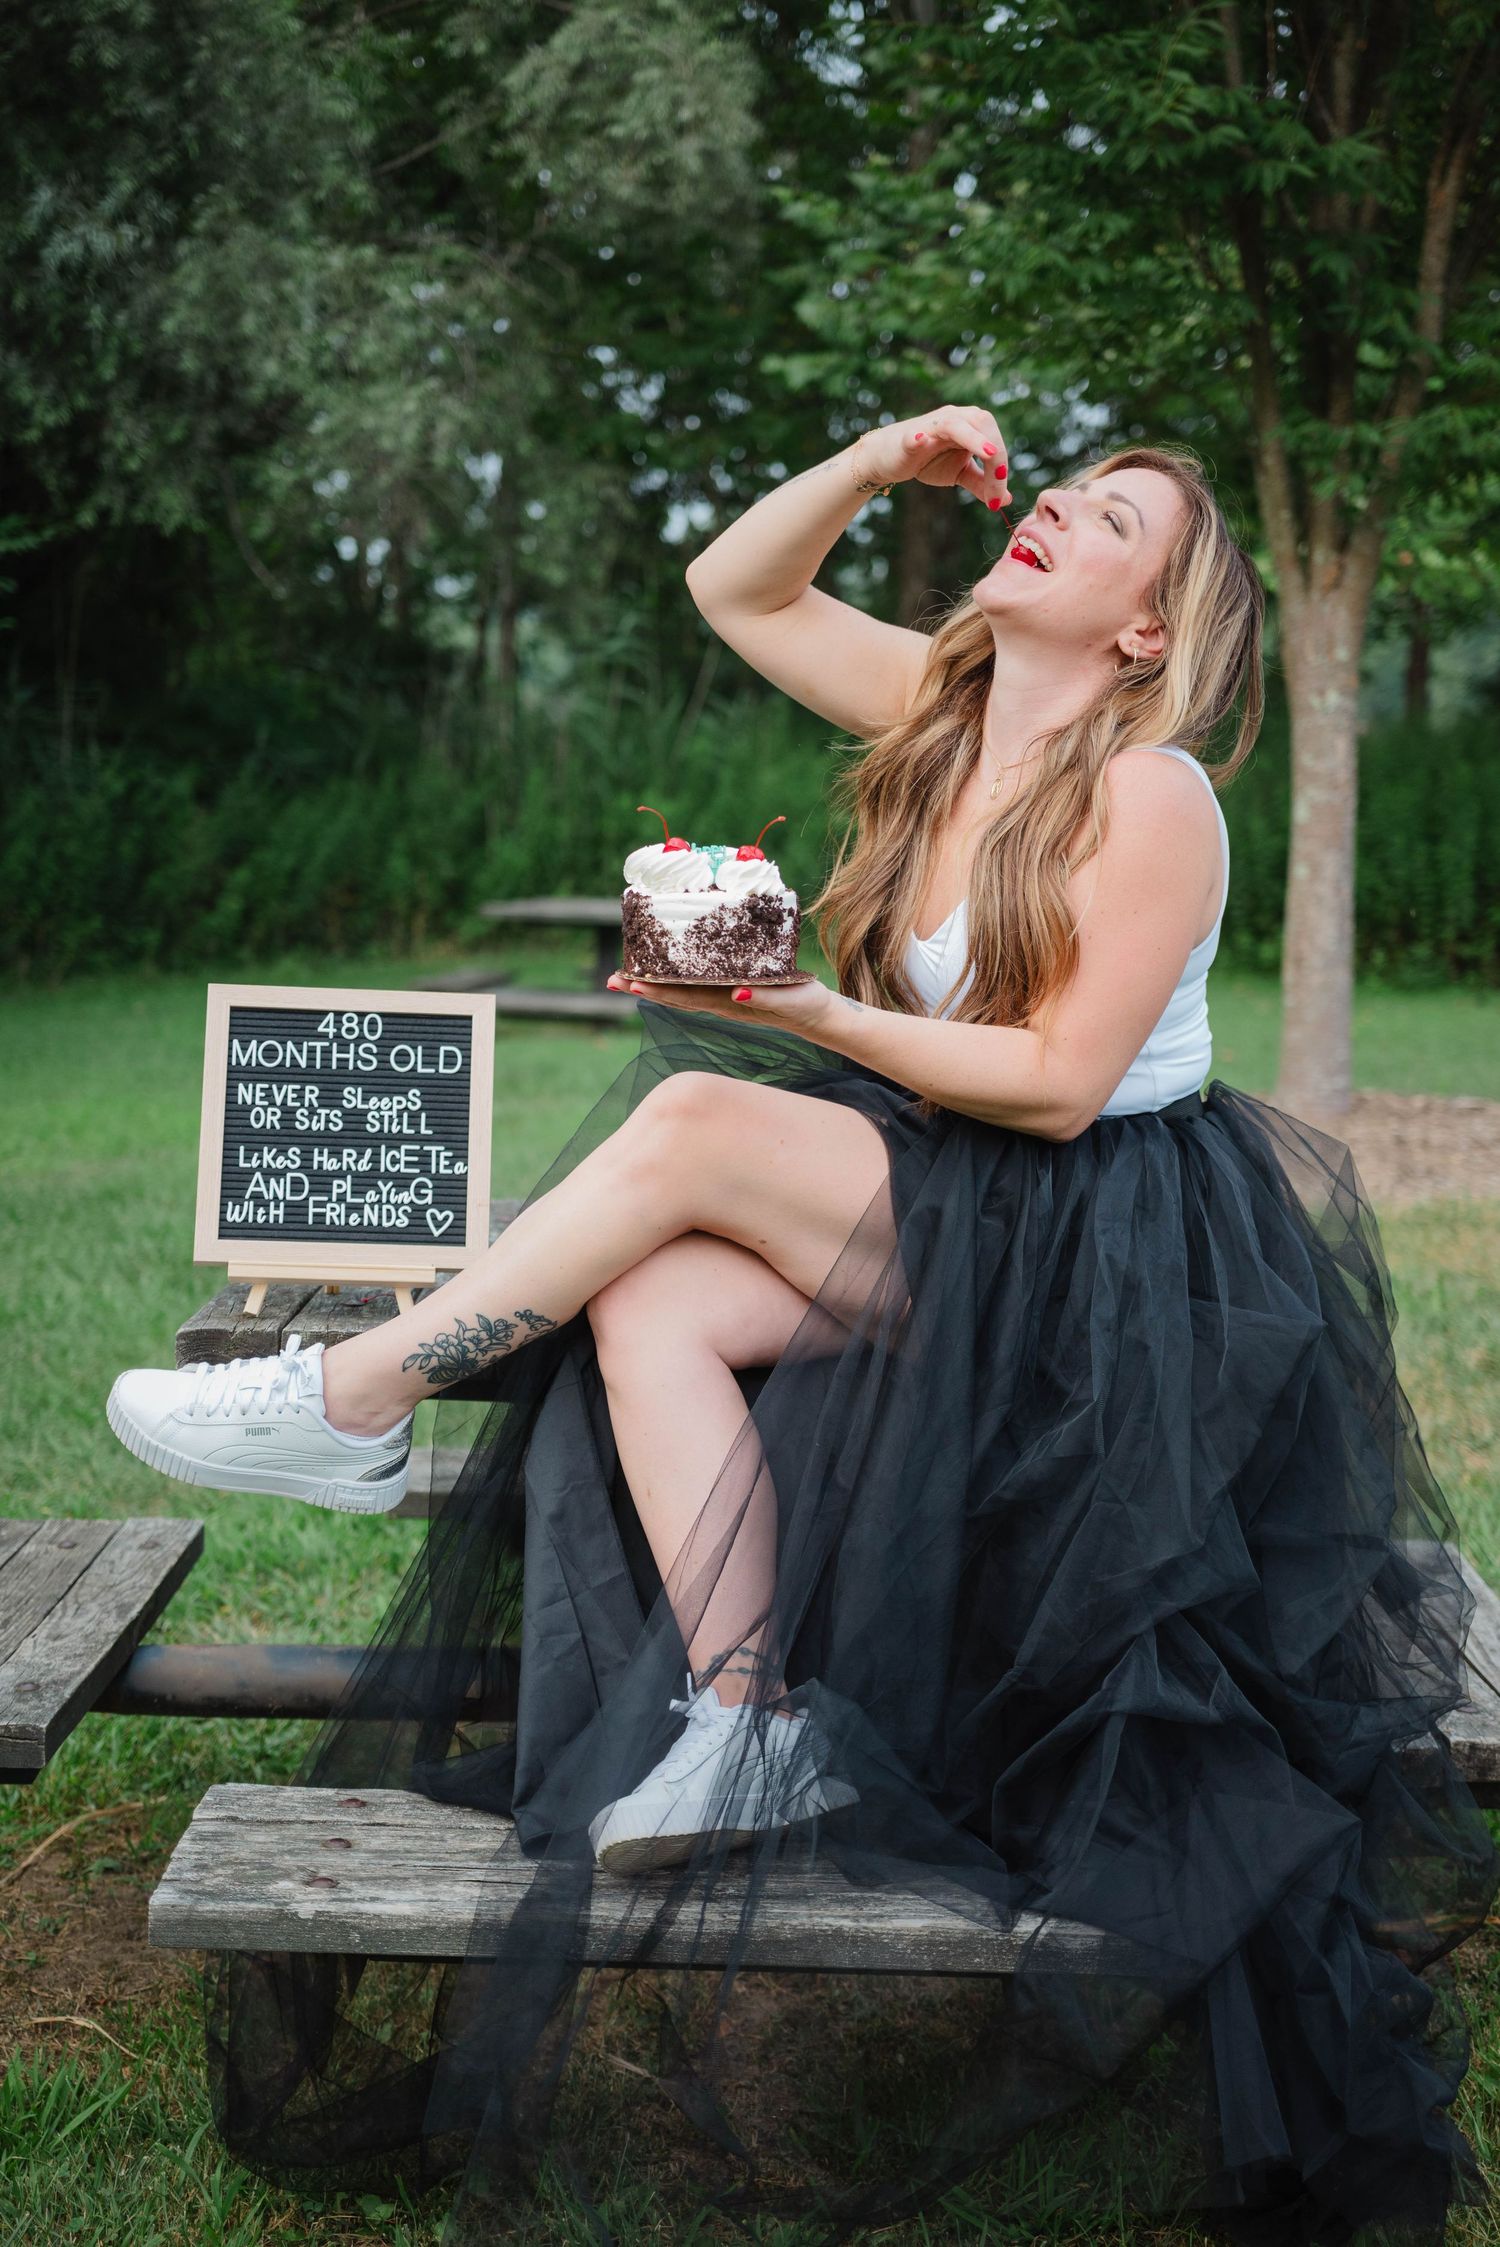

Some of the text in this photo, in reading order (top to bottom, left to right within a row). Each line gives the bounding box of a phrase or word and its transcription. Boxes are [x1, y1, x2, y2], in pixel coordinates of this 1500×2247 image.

[318, 1012, 383, 1041] 480
[231, 1038, 462, 1074] MONTHS OLD
[237, 1083, 320, 1108] NEVER
[250, 1107, 281, 1130] OR
[244, 1171, 310, 1201] AND
[245, 1426, 272, 1437] PUMA
